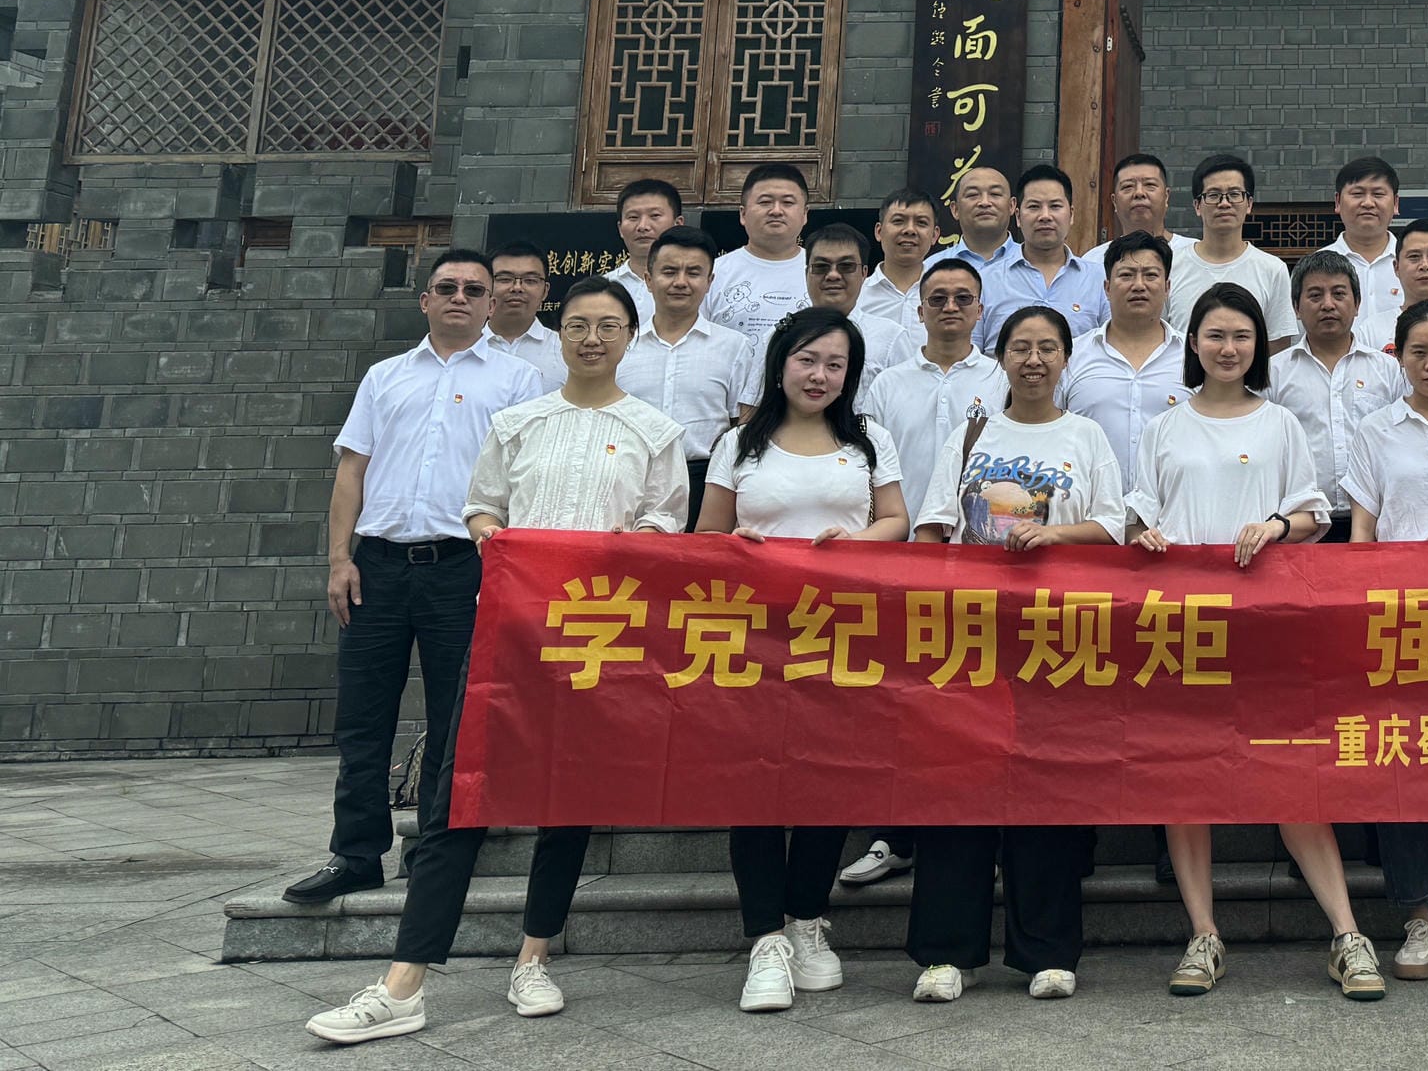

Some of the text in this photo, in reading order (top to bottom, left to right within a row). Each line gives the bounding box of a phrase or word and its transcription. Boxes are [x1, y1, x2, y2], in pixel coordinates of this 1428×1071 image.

[540, 575, 1234, 690] 学党纪明规矩
